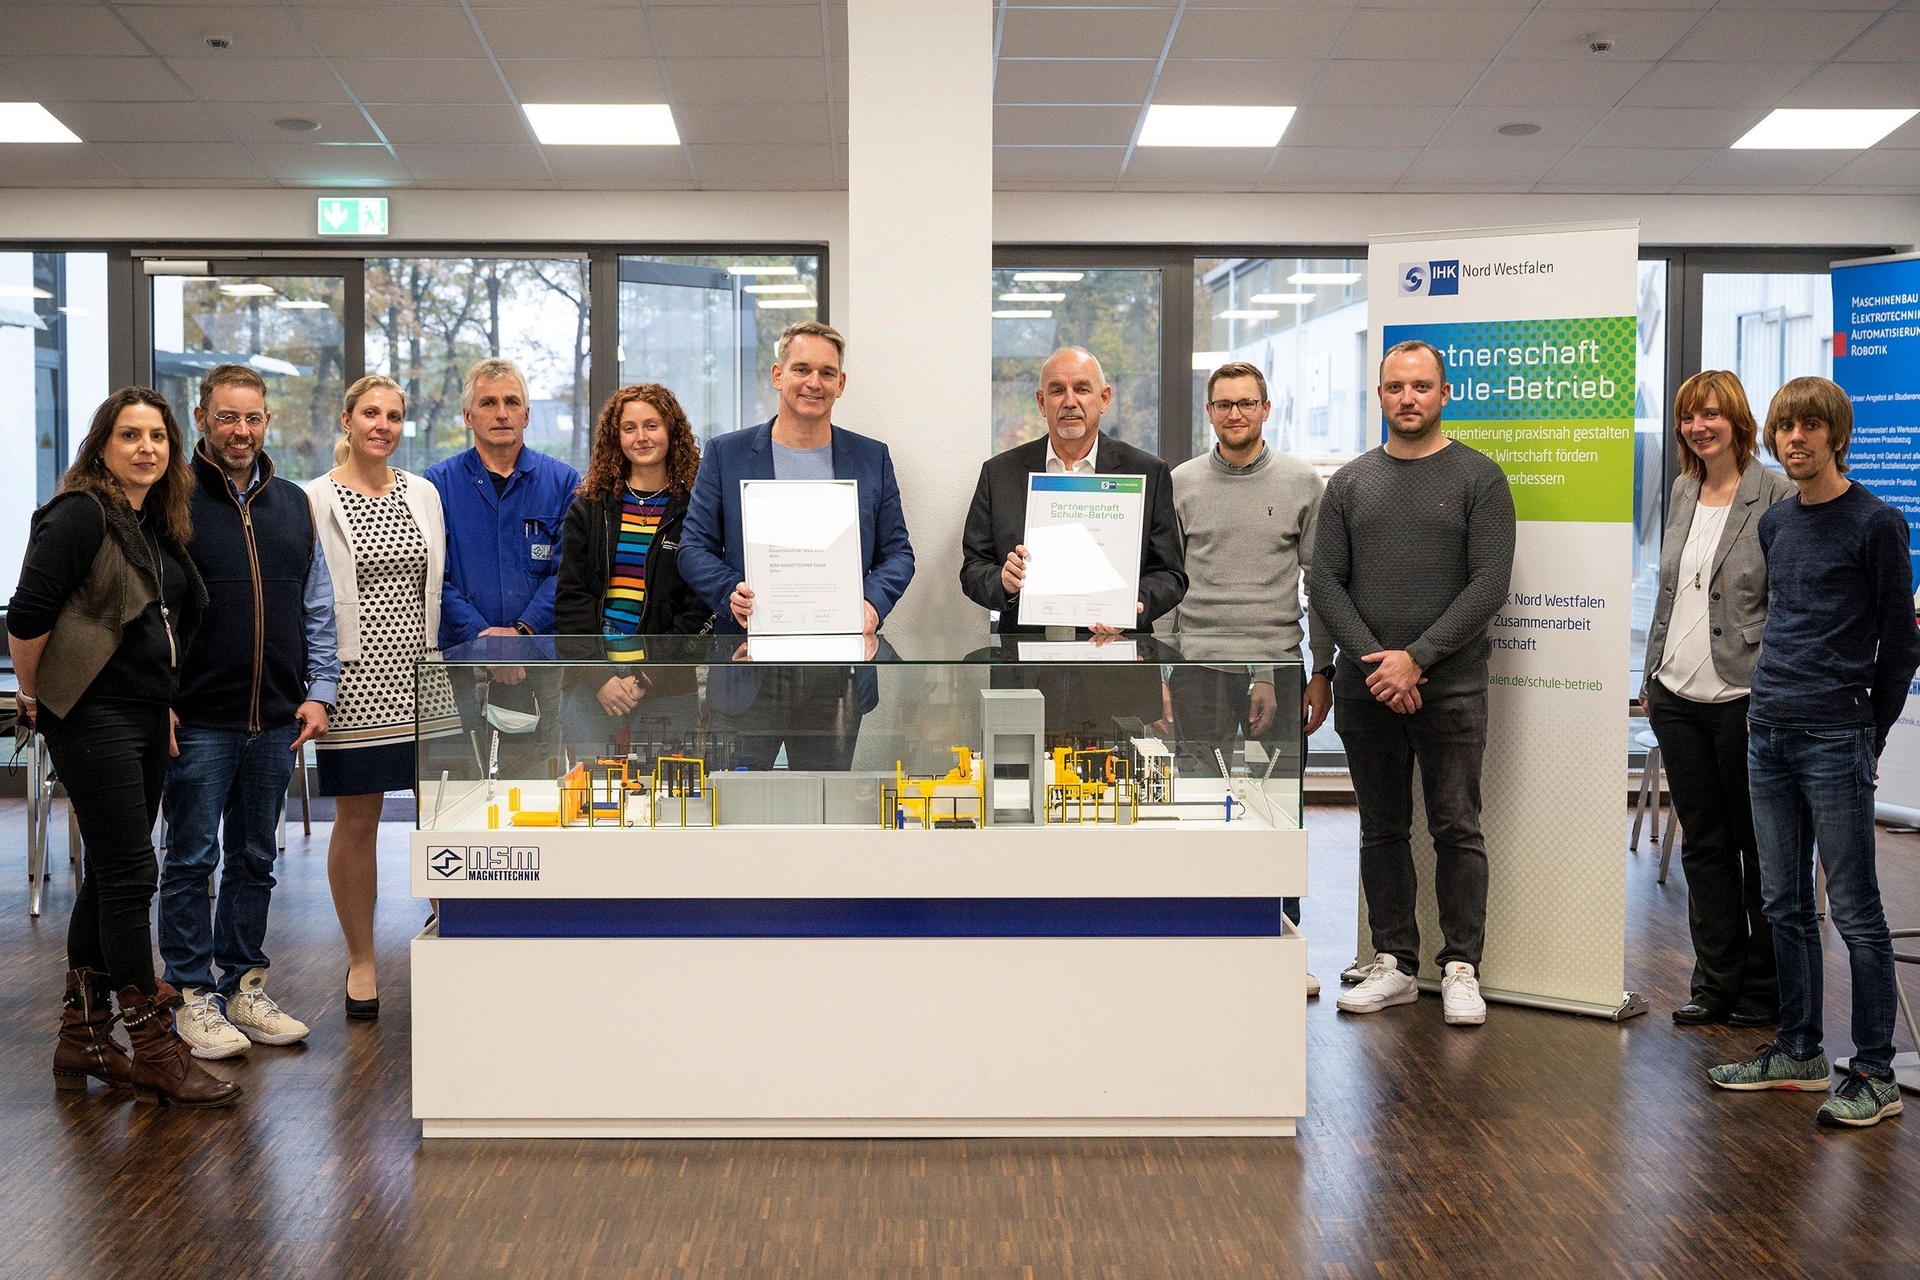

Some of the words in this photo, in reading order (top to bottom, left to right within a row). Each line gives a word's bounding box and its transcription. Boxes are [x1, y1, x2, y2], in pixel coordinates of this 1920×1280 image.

[1432, 265, 1457, 279] IHK
[1462, 263, 1491, 278] Nord
[1494, 260, 1554, 276] Westfalen
[1851, 293, 1919, 308] MASCHINENBAU
[1438, 340, 1600, 367] tnerschaft
[1851, 344, 1888, 356] ROBOTIK
[1450, 375, 1615, 401] ule-Betrieb
[1866, 394, 1887, 403] Angebot
[1441, 427, 1513, 443] sorientierung
[1515, 426, 1571, 441] praxisnah
[1573, 426, 1630, 442] gestalten
[1495, 449, 1553, 462] Wirtschaft
[1556, 448, 1598, 462] fördern
[1051, 502, 1120, 512] Partnerschaft
[1050, 510, 1125, 520] Schule-Betrieb
[1514, 593, 1542, 606] Nord
[1544, 594, 1606, 609] Westfalen
[1494, 614, 1591, 631] Zusammenarbeit
[1487, 636, 1537, 650] irtschaft
[1489, 674, 1603, 691] alen.de/schule-betrieb
[468, 845, 540, 870] nsm
[468, 870, 540, 881] MAGNETTECHNIK
